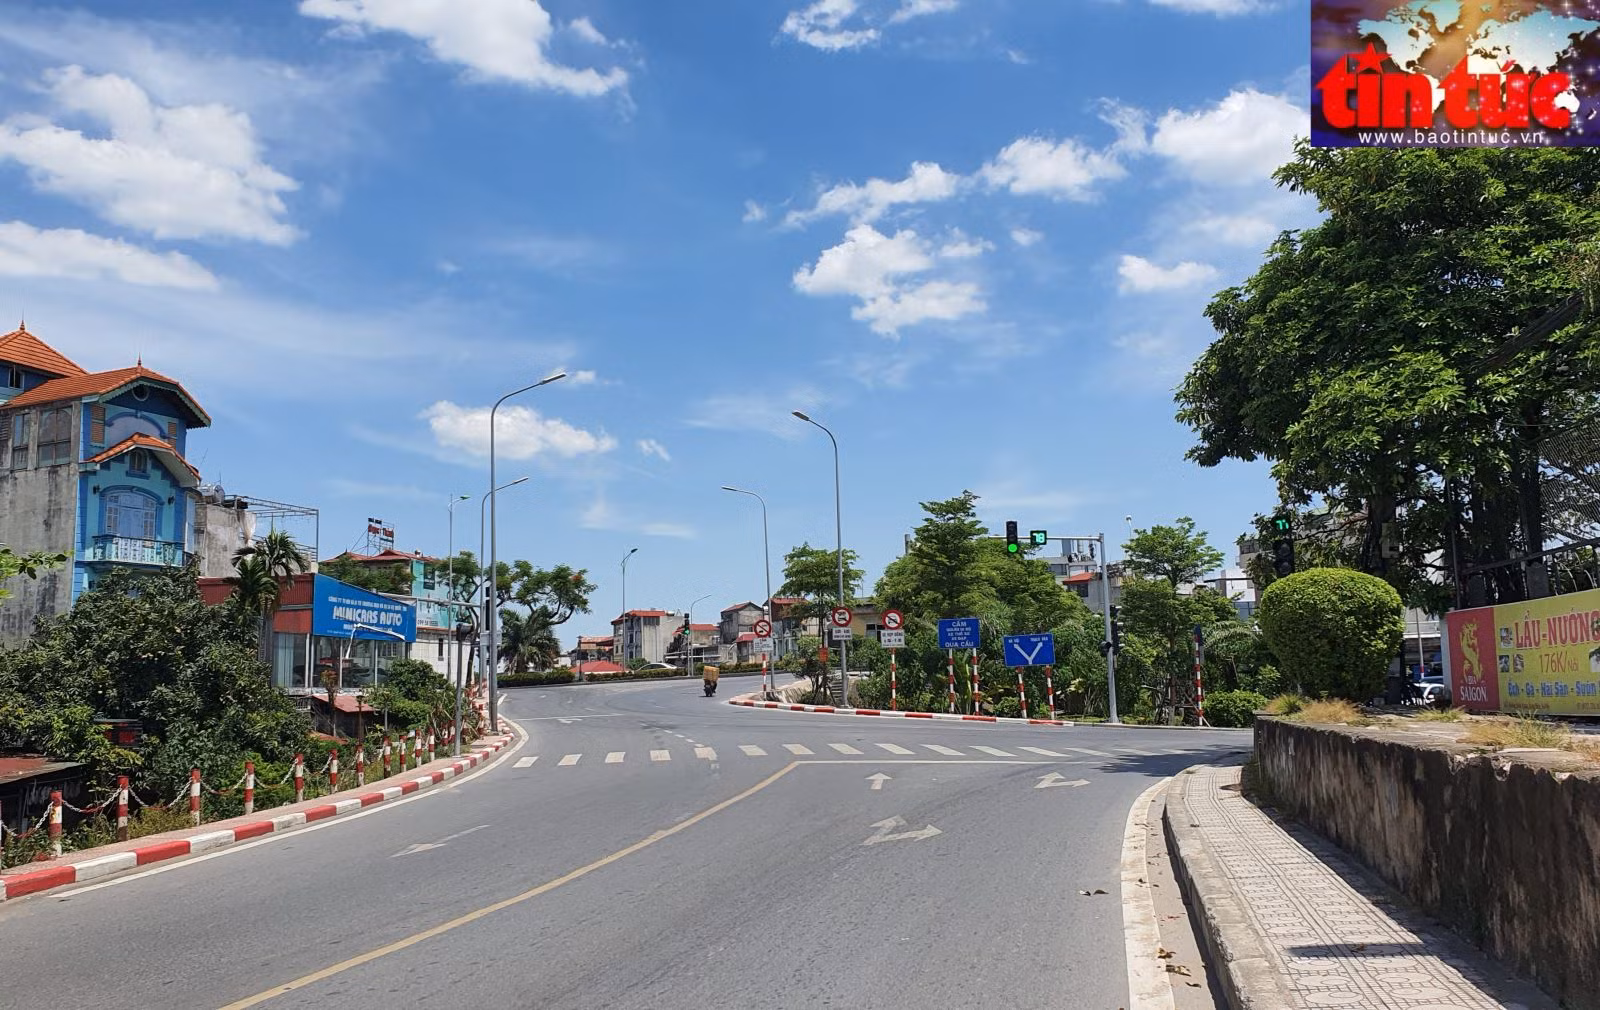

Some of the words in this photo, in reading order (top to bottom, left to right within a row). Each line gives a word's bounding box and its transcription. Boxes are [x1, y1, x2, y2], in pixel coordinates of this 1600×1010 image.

[1032, 533, 1045, 543] 78
[332, 606, 379, 624] MINICARS
[380, 611, 403, 626] AUTO
[1460, 686, 1488, 702] SAIGON
